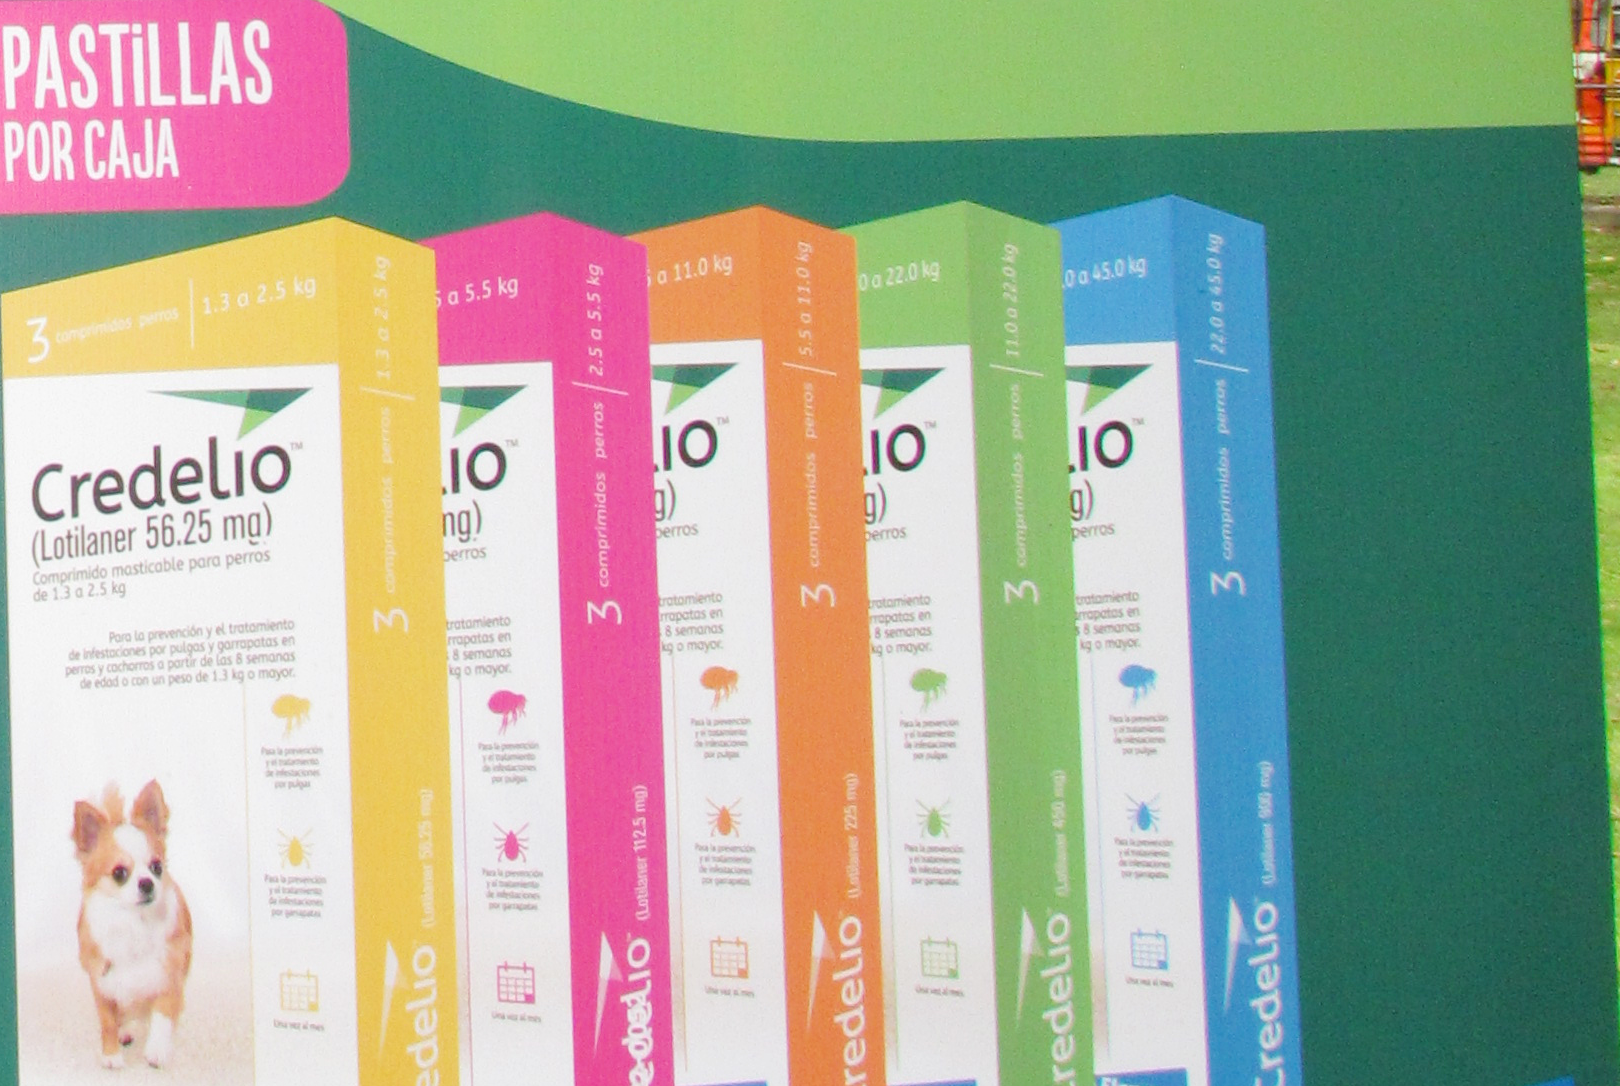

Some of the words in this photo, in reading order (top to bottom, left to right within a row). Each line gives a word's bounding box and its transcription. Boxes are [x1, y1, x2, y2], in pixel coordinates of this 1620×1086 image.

[3, 120, 75, 182] POR
[84, 117, 179, 180] CAJA
[796, 241, 813, 263] kg
[1206, 233, 1224, 254] kg
[586, 263, 604, 286] kg
[657, 270, 668, 285] a
[674, 257, 709, 281] 11.0
[713, 255, 733, 276] kg
[871, 274, 881, 288] a
[886, 262, 918, 287] 22.0
[922, 261, 940, 282] kg
[1079, 270, 1089, 285] a
[1090, 259, 1125, 280] 45.0
[1128, 254, 1147, 280] kg
[1206, 257, 1223, 295] 45.0
[447, 290, 459, 306] a
[465, 279, 492, 302] 5.5
[497, 276, 519, 299] kg
[796, 266, 811, 305] 11.0
[26, 316, 50, 363] 3
[139, 307, 179, 328] perros
[203, 292, 231, 315] 1.3
[236, 292, 250, 308] a
[257, 280, 287, 304] 2.5
[293, 276, 317, 299] kg
[586, 291, 602, 322] 5.5
[800, 312, 812, 324] a
[1211, 301, 1224, 312] a
[590, 328, 603, 341] a
[798, 329, 813, 357] 5.5
[1209, 316, 1226, 354] 22.0
[588, 346, 604, 377] 2.5
[804, 382, 818, 439] perros
[593, 402, 607, 459] perros
[31, 525, 137, 568] (Lotilaner
[146, 509, 212, 550] 56.25
[223, 501, 273, 546] mg)
[33, 565, 108, 588] Comprimido
[111, 558, 185, 576] masticable
[188, 555, 221, 572] para
[225, 550, 271, 569] perros
[33, 588, 49, 603] de
[52, 584, 71, 601] 1.3
[74, 587, 84, 599] a
[87, 581, 107, 598] 2.5
[111, 580, 127, 599] kg
[801, 582, 835, 607] 3
[1004, 579, 1039, 605] 3
[1211, 570, 1247, 596] 3
[373, 607, 409, 633] 3
[587, 600, 621, 625] 3
[660, 610, 706, 624] rrapatas
[1075, 607, 1123, 622] arrapatas
[447, 633, 494, 647] rrapatas
